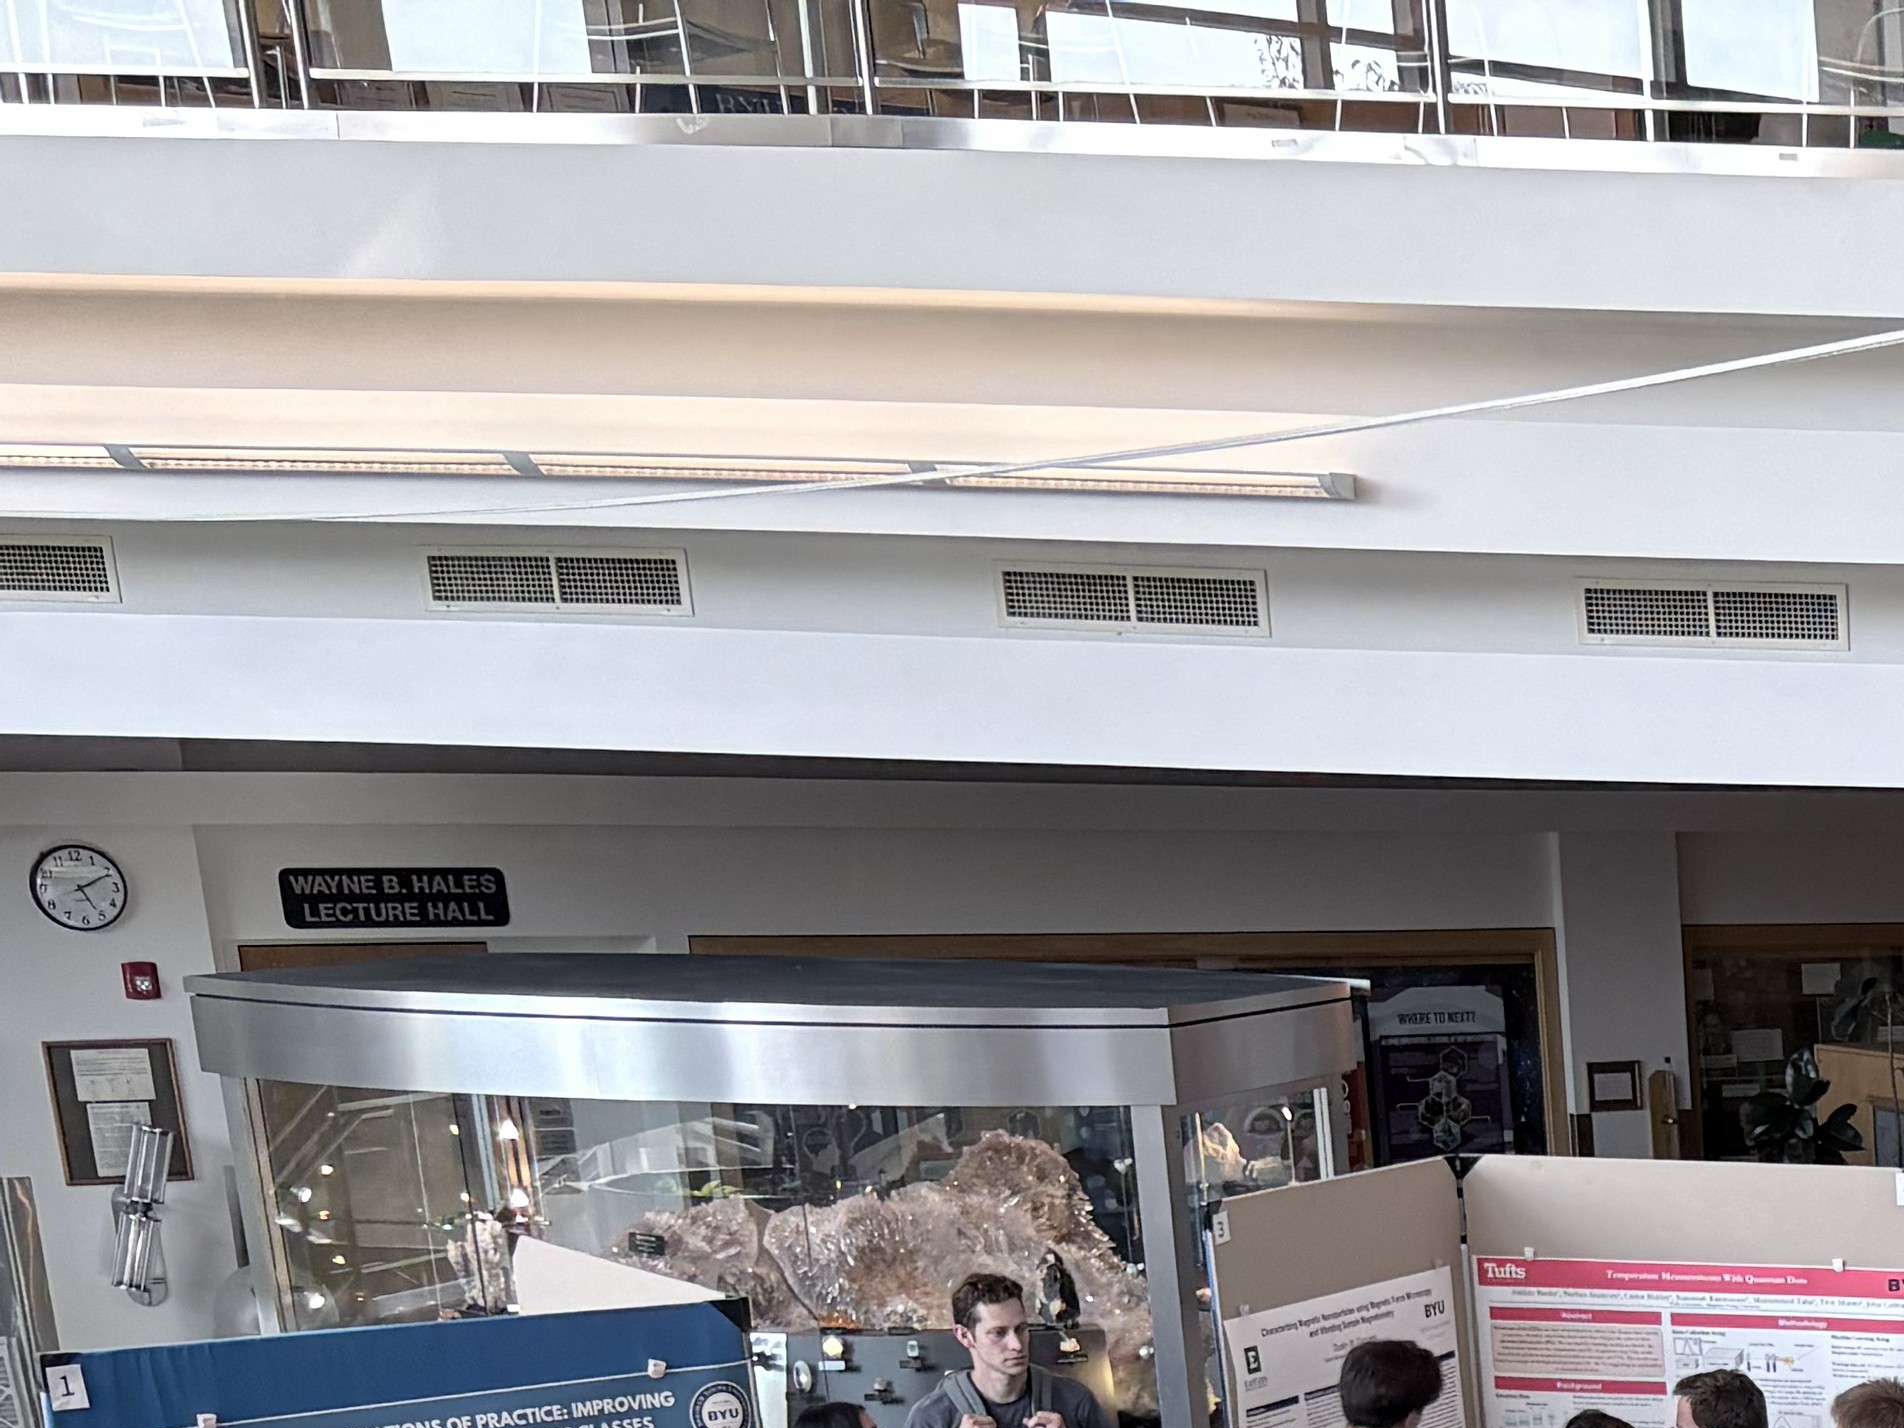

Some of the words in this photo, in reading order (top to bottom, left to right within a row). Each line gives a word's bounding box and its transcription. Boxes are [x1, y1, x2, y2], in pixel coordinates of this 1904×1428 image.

[289, 875, 376, 894] WAYNE
[382, 875, 407, 894] B.
[411, 874, 496, 893] HALES
[303, 902, 420, 922] LECTURE
[427, 901, 495, 920] HALL
[1216, 1221, 1225, 1238] 3
[1484, 1262, 1526, 1279] Tufts
[1424, 1300, 1445, 1318] BYU
[61, 1375, 75, 1397] 1
[476, 1406, 569, 1428] PRACTICE:
[572, 1391, 675, 1418] IMPROVING
[708, 1408, 739, 1422] BYU
